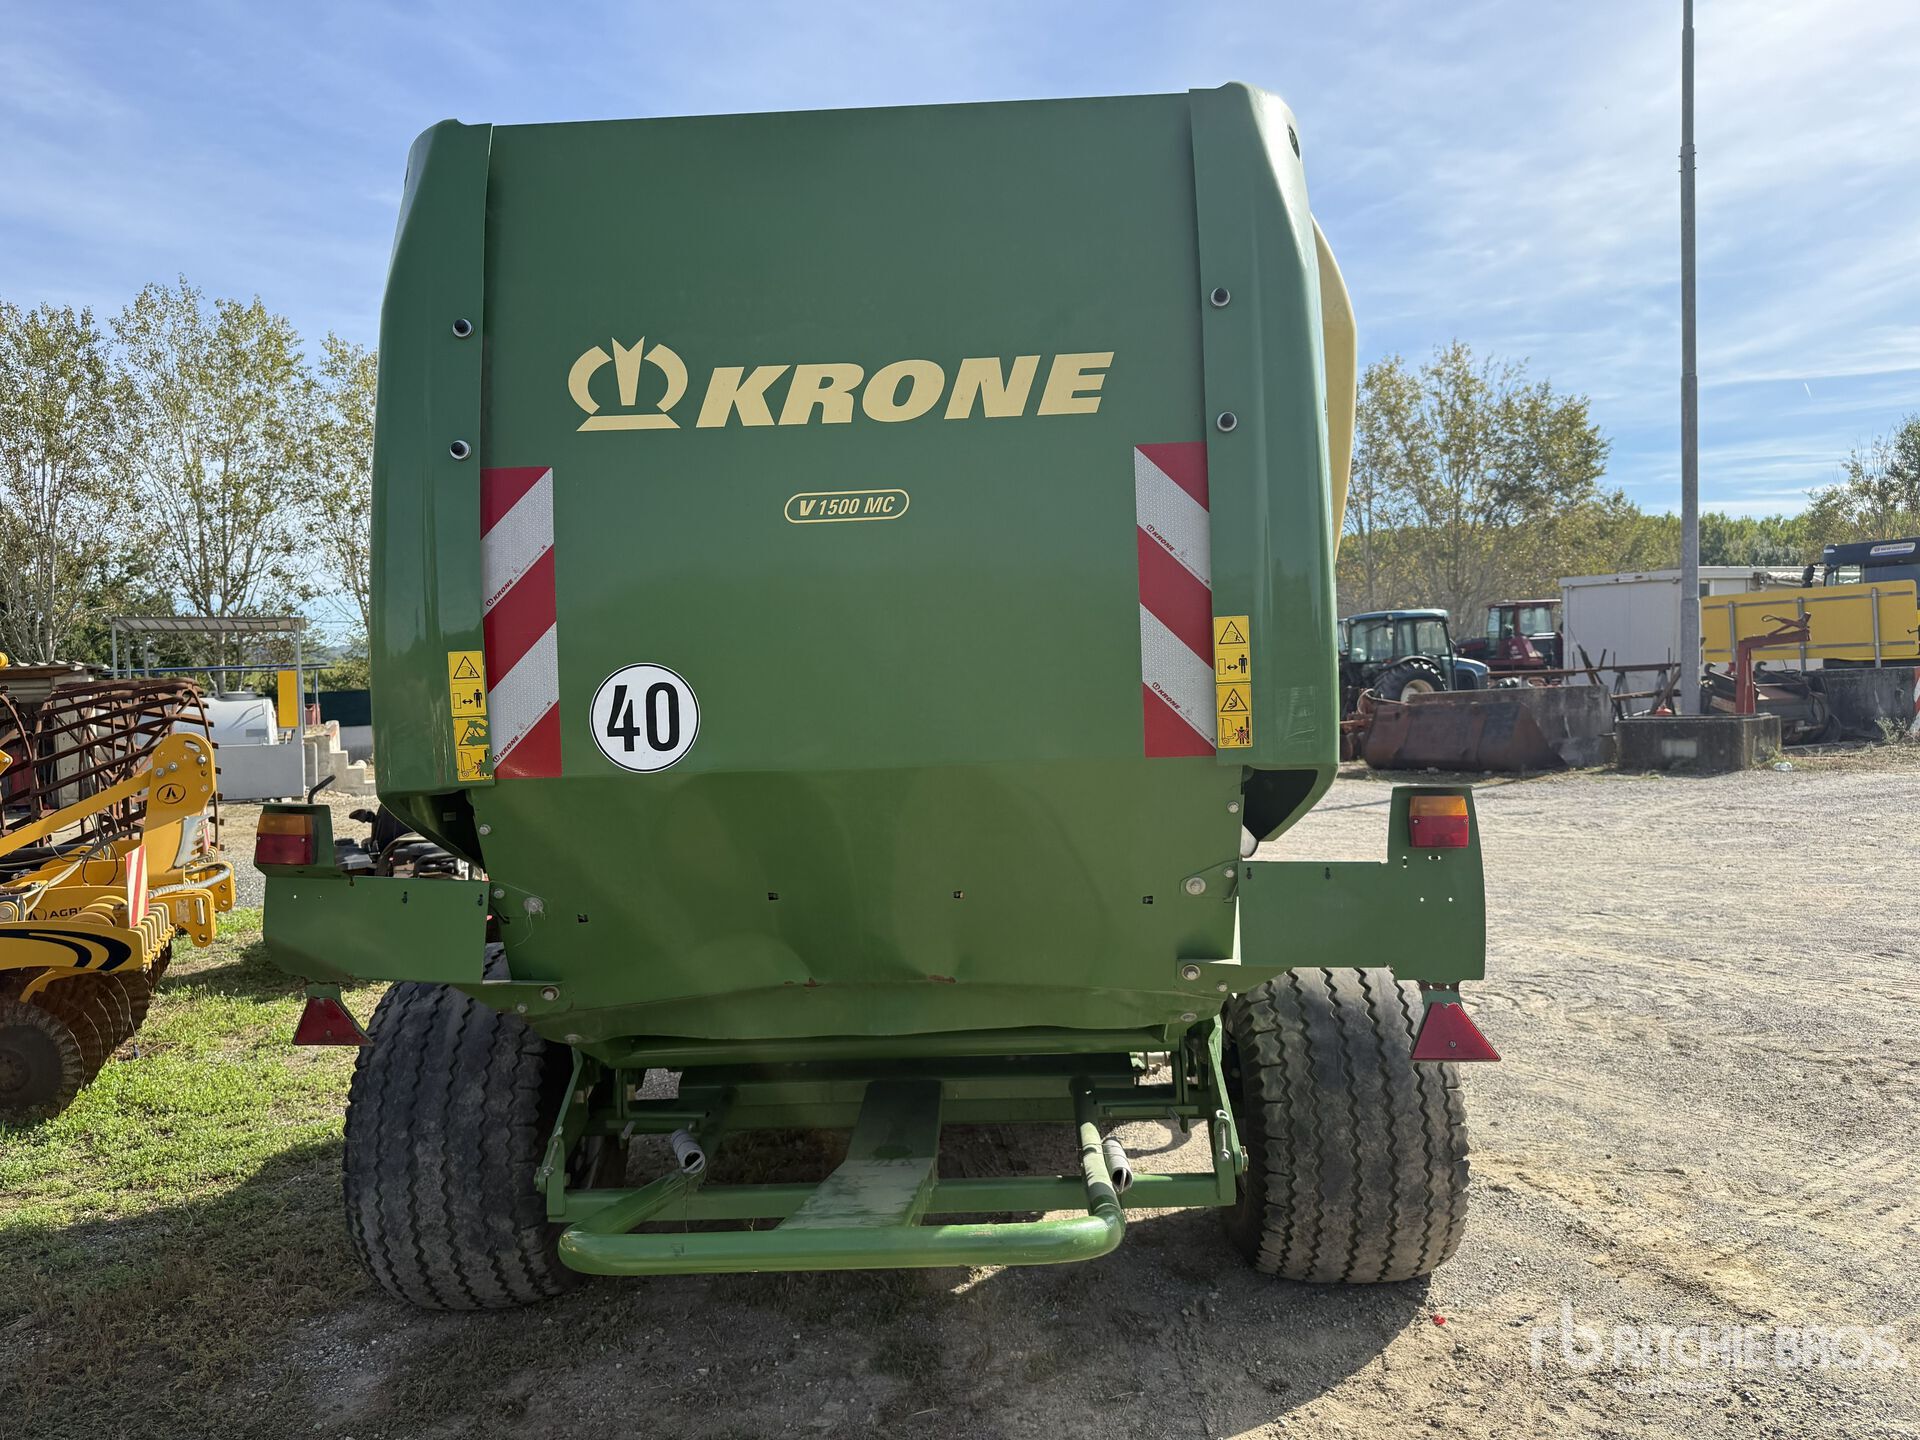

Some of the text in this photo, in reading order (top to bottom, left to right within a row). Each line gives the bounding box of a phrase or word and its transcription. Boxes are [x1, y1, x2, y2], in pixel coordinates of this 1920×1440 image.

[695, 351, 1115, 429] KRONE
[799, 495, 896, 516] V 1500 MC
[1151, 531, 1176, 552] KRONE
[492, 578, 514, 602] KRONE
[1157, 689, 1181, 710] KRONE
[606, 681, 680, 752] 40
[499, 735, 520, 758] KRONE
